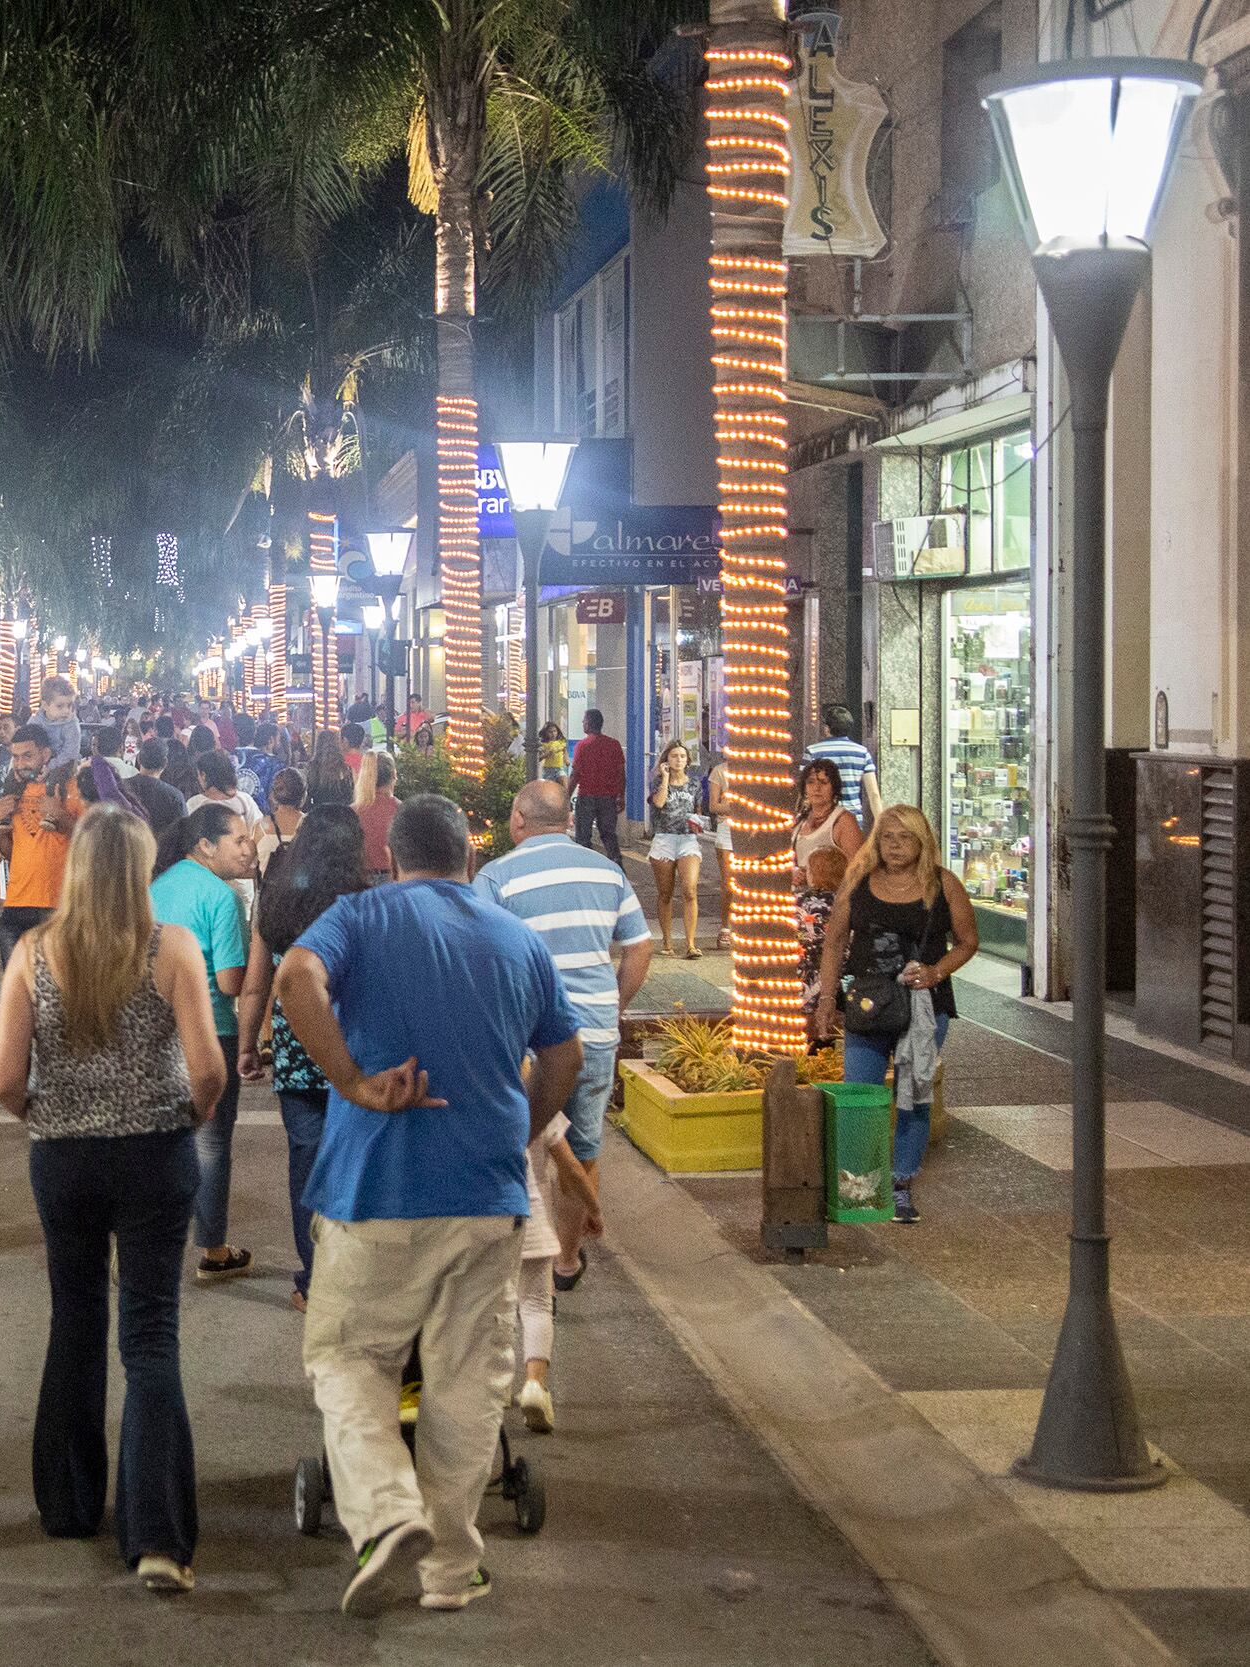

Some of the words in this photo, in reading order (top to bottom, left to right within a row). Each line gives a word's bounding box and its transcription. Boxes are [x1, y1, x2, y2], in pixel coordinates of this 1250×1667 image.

[808, 20, 836, 240] ALEXIS
[572, 559, 640, 568] EFECTIVO
[647, 559, 664, 568] EN
[670, 559, 686, 568] EL
[694, 559, 724, 568] ACT
